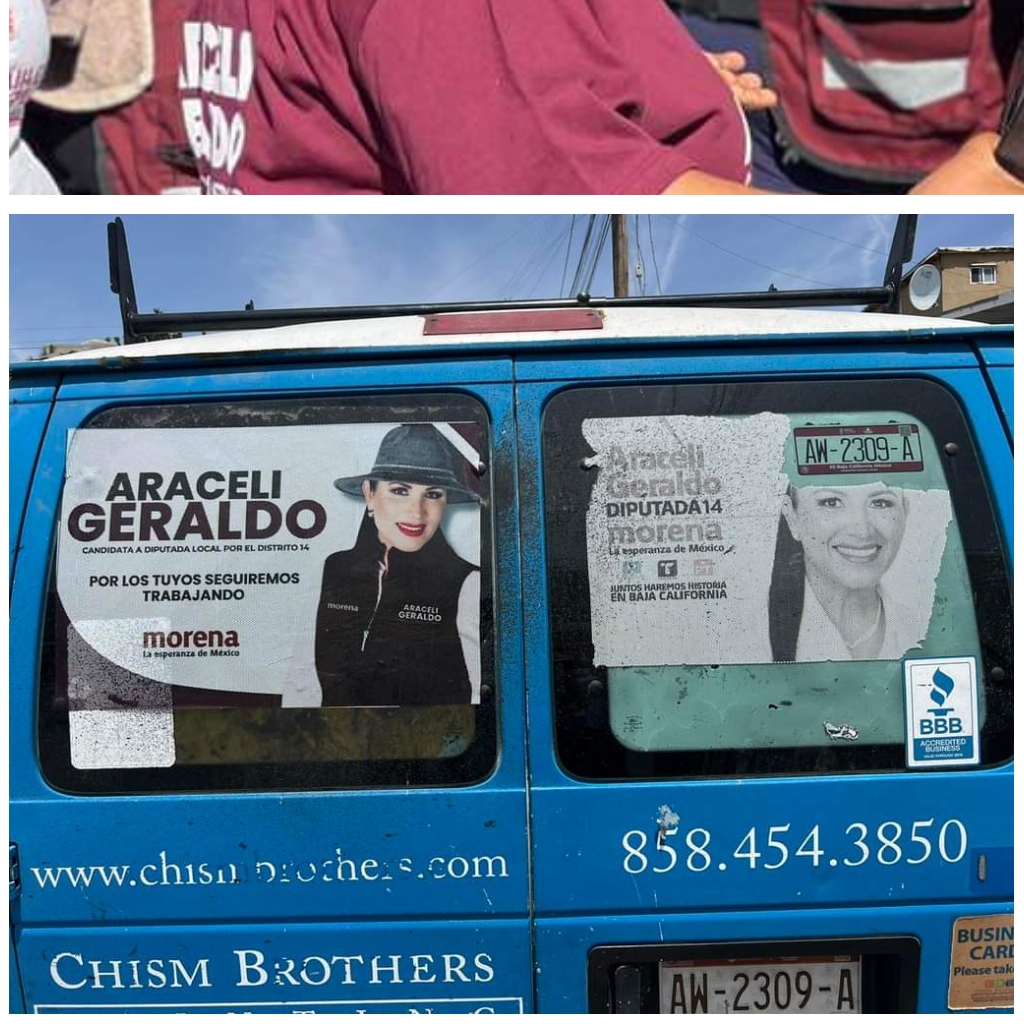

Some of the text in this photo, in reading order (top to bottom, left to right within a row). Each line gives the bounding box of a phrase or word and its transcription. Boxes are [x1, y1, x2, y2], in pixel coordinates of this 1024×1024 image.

[606, 443, 705, 471] Araceli
[805, 436, 915, 464] AW-2309-A
[105, 470, 282, 501] ARACELI
[606, 470, 722, 499] Geraldo
[68, 499, 327, 542] GERALDO
[606, 523, 723, 544] morena
[82, 546, 134, 554] CANDIDATA
[192, 545, 221, 553] LOCAL
[258, 544, 297, 552] DISTRITO
[622, 546, 671, 556] esperanza
[674, 544, 686, 553] de
[89, 572, 300, 587] POR LOS TUYOS SEGUIREMOS
[610, 581, 727, 592] JUNTOS HAREMOS HISTORIA
[143, 589, 245, 602] TRABAJANDO
[611, 590, 728, 602] EN BAJA CALIFORNIA
[398, 610, 442, 622] GERALDO
[403, 604, 438, 614] ARACELI
[143, 630, 240, 648] morena
[143, 649, 240, 659] La esperanza de México
[919, 718, 963, 735] BBB
[920, 738, 966, 747] ACCREDITED
[925, 745, 961, 753] BUSINESS
[621, 818, 968, 874] 858.454.3850
[49, 948, 495, 990] CHISM BROTHERS
[954, 966, 991, 977] Please
[671, 968, 855, 1014] AW-2309-A
